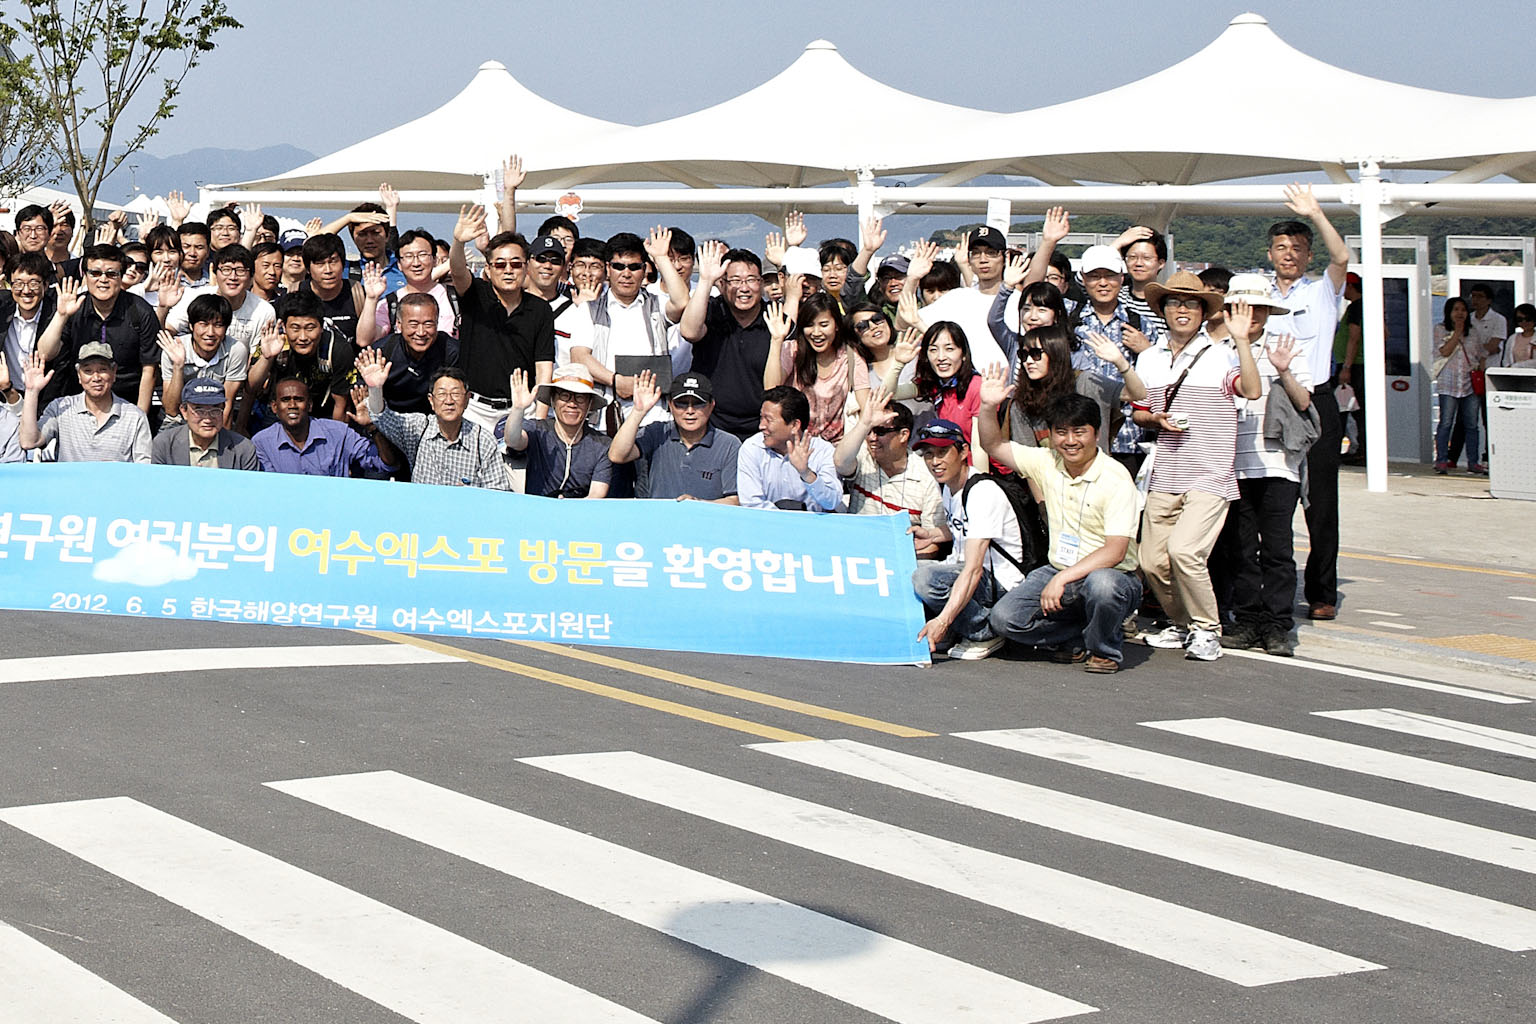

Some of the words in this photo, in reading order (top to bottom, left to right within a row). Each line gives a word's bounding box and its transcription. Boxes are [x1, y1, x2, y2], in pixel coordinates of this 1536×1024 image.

[544, 237, 554, 248] S
[107, 517, 278, 573] 여러분의
[287, 527, 508, 579] 여수엑스포
[519, 538, 653, 588] 방문을
[663, 543, 895, 597] 환영합니다
[50, 591, 112, 614] 2012.
[125, 596, 147, 616] 6.
[161, 597, 177, 616] 5
[190, 596, 378, 629] 한국해양연구원
[392, 606, 613, 640] 여수엑스포지원단
